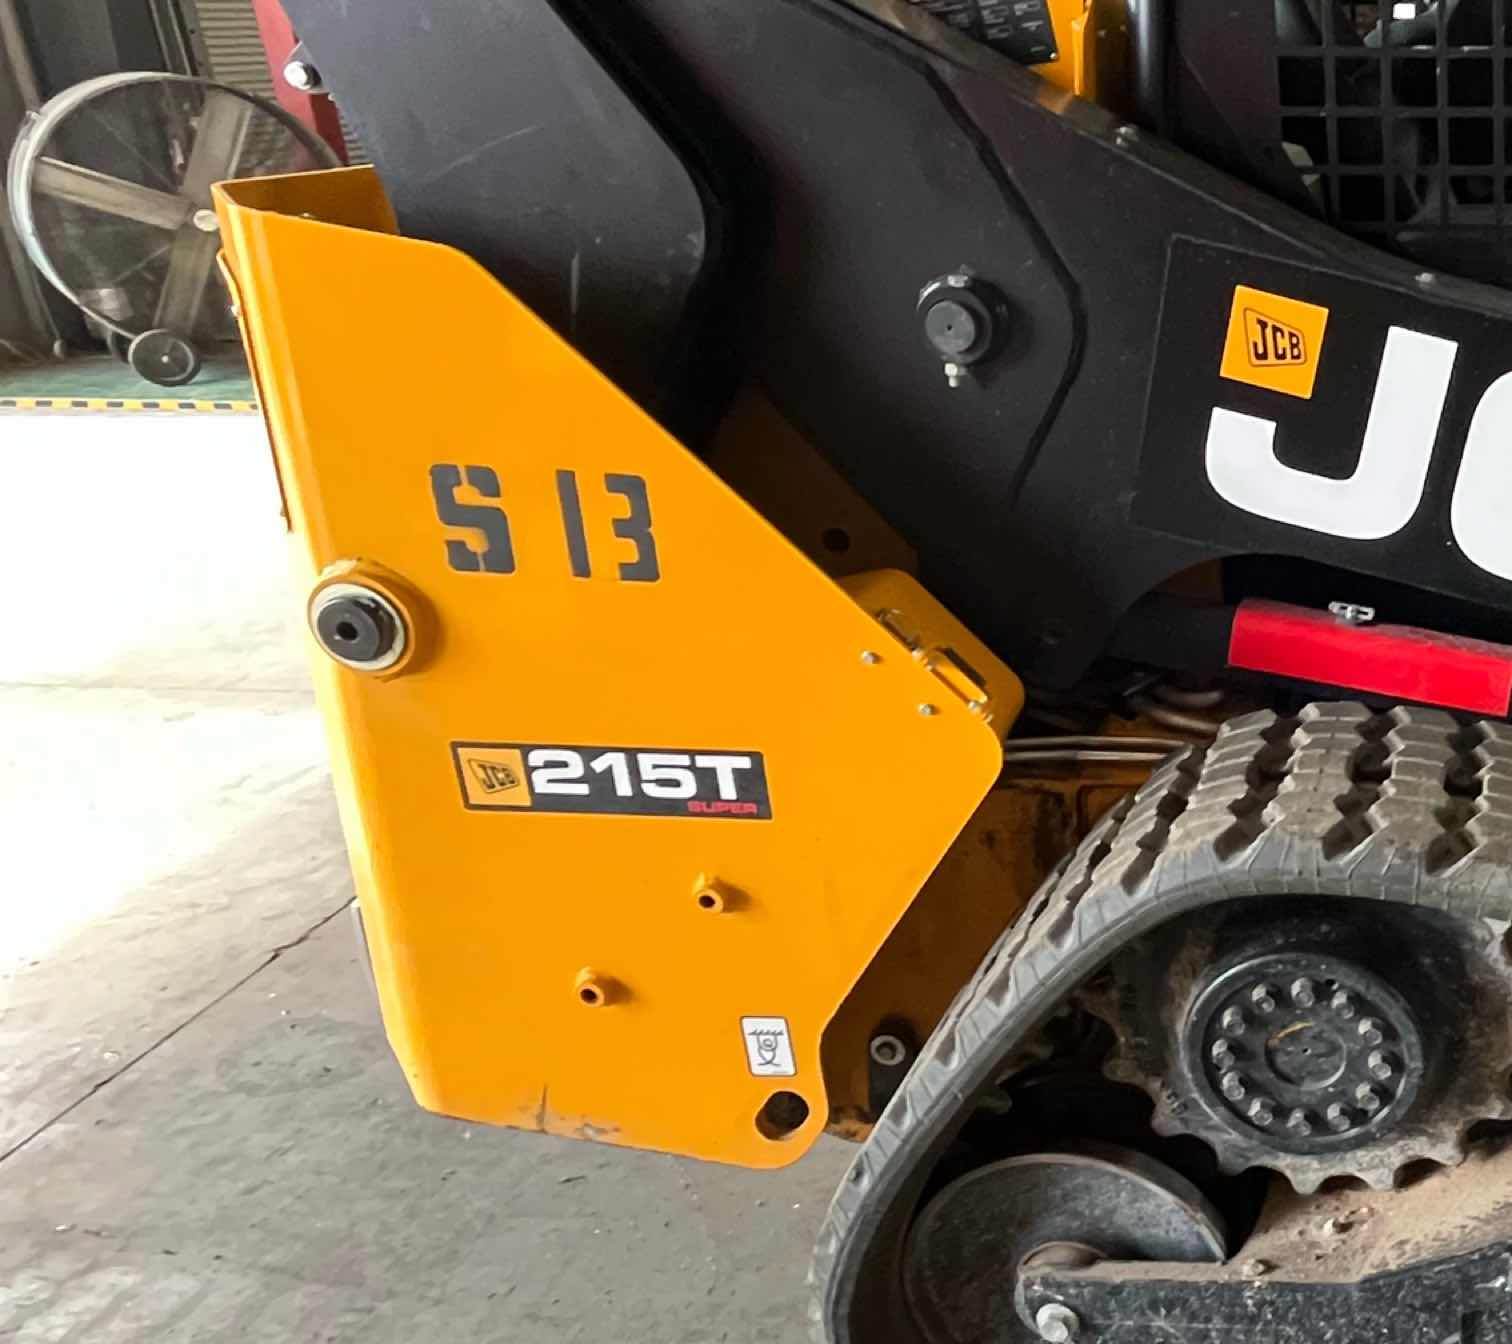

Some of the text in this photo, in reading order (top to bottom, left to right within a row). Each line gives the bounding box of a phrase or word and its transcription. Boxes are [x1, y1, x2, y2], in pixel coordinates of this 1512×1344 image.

[1250, 317, 1303, 362] JCB
[477, 748, 752, 800] JCB 215T
[687, 801, 758, 815] SUPER
